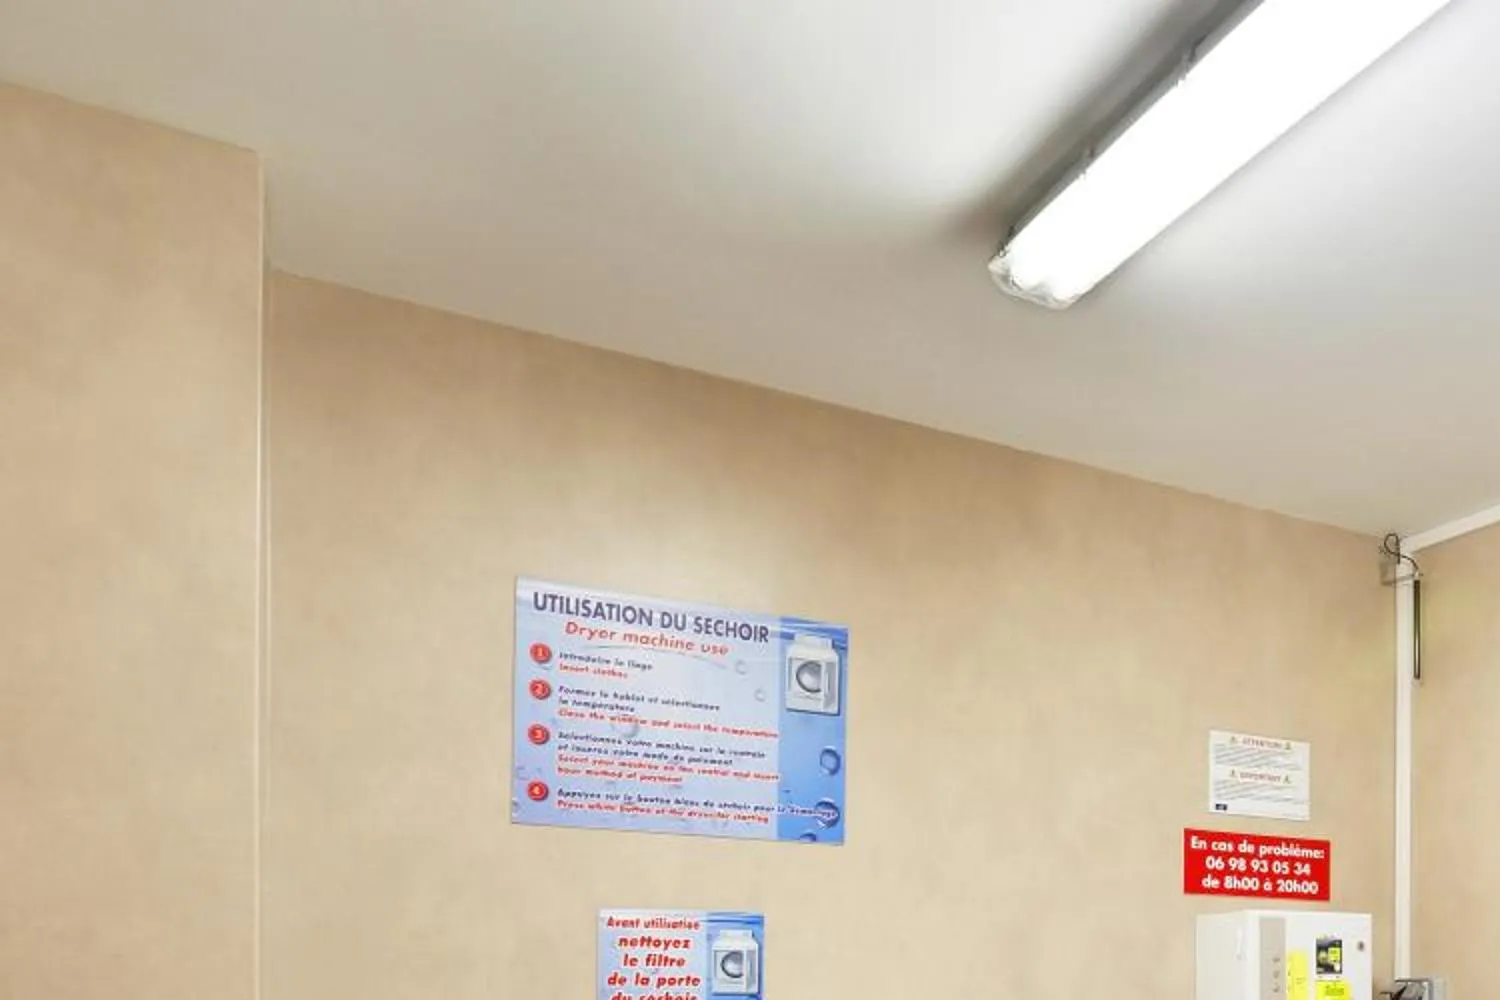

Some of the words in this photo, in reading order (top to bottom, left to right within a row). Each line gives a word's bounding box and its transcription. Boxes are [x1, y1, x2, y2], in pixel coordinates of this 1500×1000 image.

[533, 591, 653, 627] UTILISATION
[660, 611, 686, 632] DU
[694, 616, 770, 643] SECHOIR
[565, 621, 617, 643] Dryer
[622, 632, 696, 652] machine
[701, 643, 730, 656] use
[1190, 836, 1207, 850] En
[1211, 840, 1234, 853] cas
[1238, 840, 1254, 853] de
[1205, 856, 1225, 870] 06
[1228, 857, 1246, 871] 98
[1251, 859, 1269, 873] 93
[1272, 861, 1290, 875] 05
[1293, 863, 1311, 877] 34
[1202, 875, 1220, 889] de
[1223, 876, 1260, 891] 8h00
[1263, 878, 1273, 891] à
[1277, 880, 1319, 895] 20h00
[607, 916, 640, 929] Avant
[618, 936, 692, 950] nettoyez
[623, 954, 639, 966] le
[645, 953, 687, 967] filtre
[607, 972, 627, 986] de
[635, 973, 650, 986] la
[656, 975, 701, 989] porte
